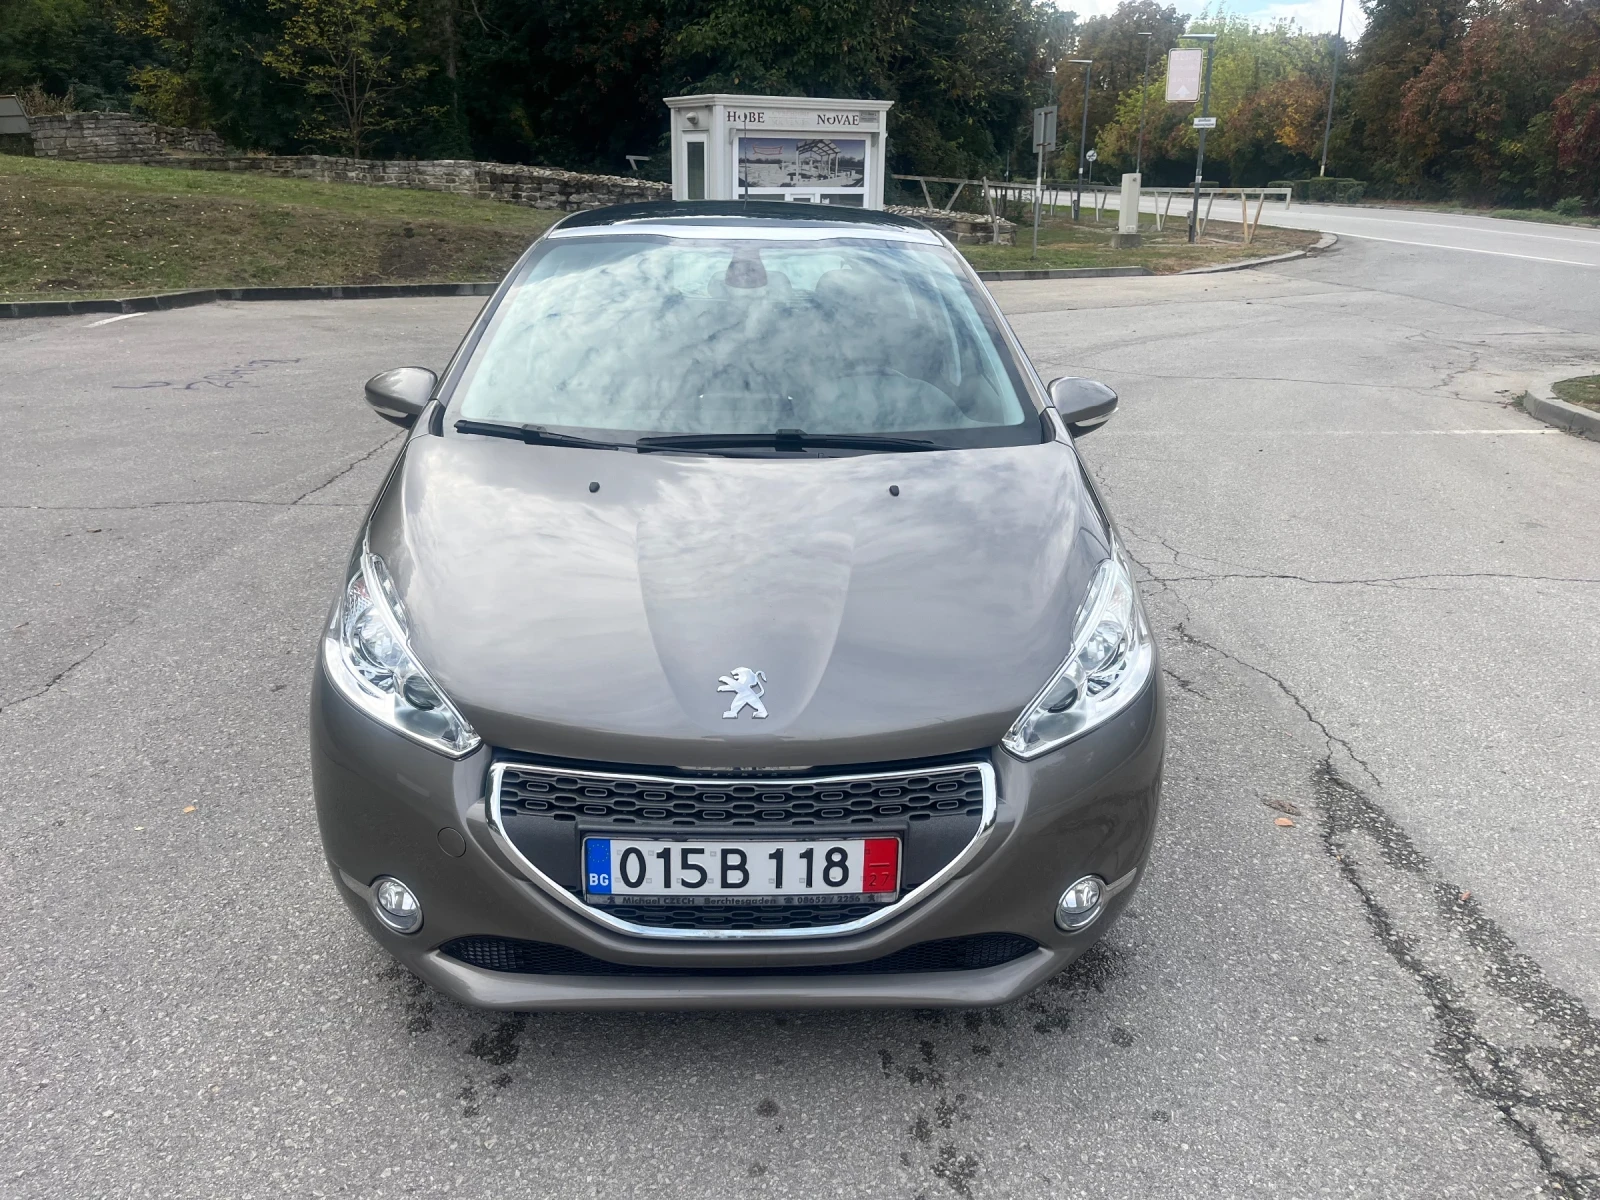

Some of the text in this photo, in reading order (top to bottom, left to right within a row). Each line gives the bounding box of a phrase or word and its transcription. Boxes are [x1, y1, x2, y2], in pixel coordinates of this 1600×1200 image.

[768, 846, 850, 888] 118
[589, 873, 609, 886] BG
[868, 871, 890, 887] 27
[622, 895, 661, 905] Michael
[663, 896, 695, 906] CZECH
[704, 896, 777, 906] Berchtesgaden
[797, 895, 827, 905] 08652
